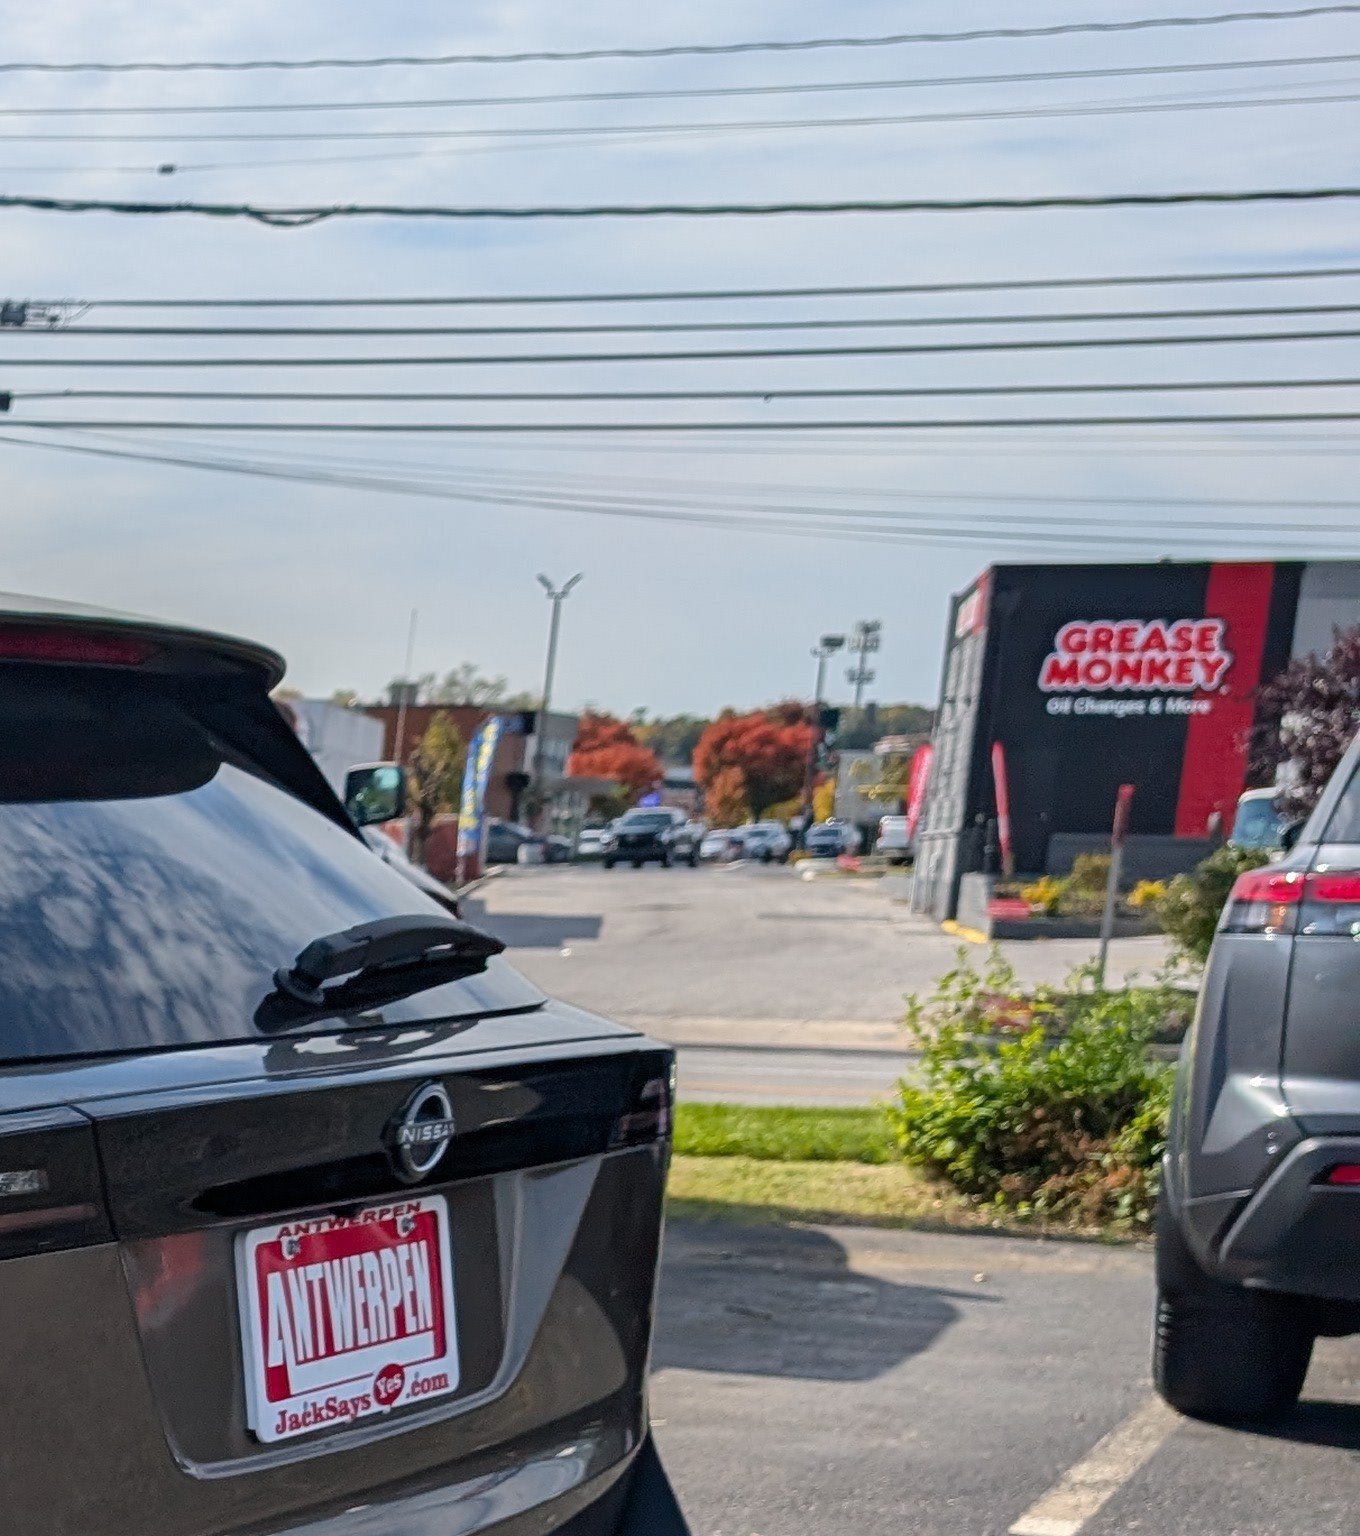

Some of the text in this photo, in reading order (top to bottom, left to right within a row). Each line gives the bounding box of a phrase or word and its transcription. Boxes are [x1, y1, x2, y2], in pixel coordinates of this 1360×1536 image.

[1059, 623, 1222, 653] GREASE
[1043, 655, 1228, 688] MONKEY
[267, 1240, 433, 1369] ANTWERPEN
